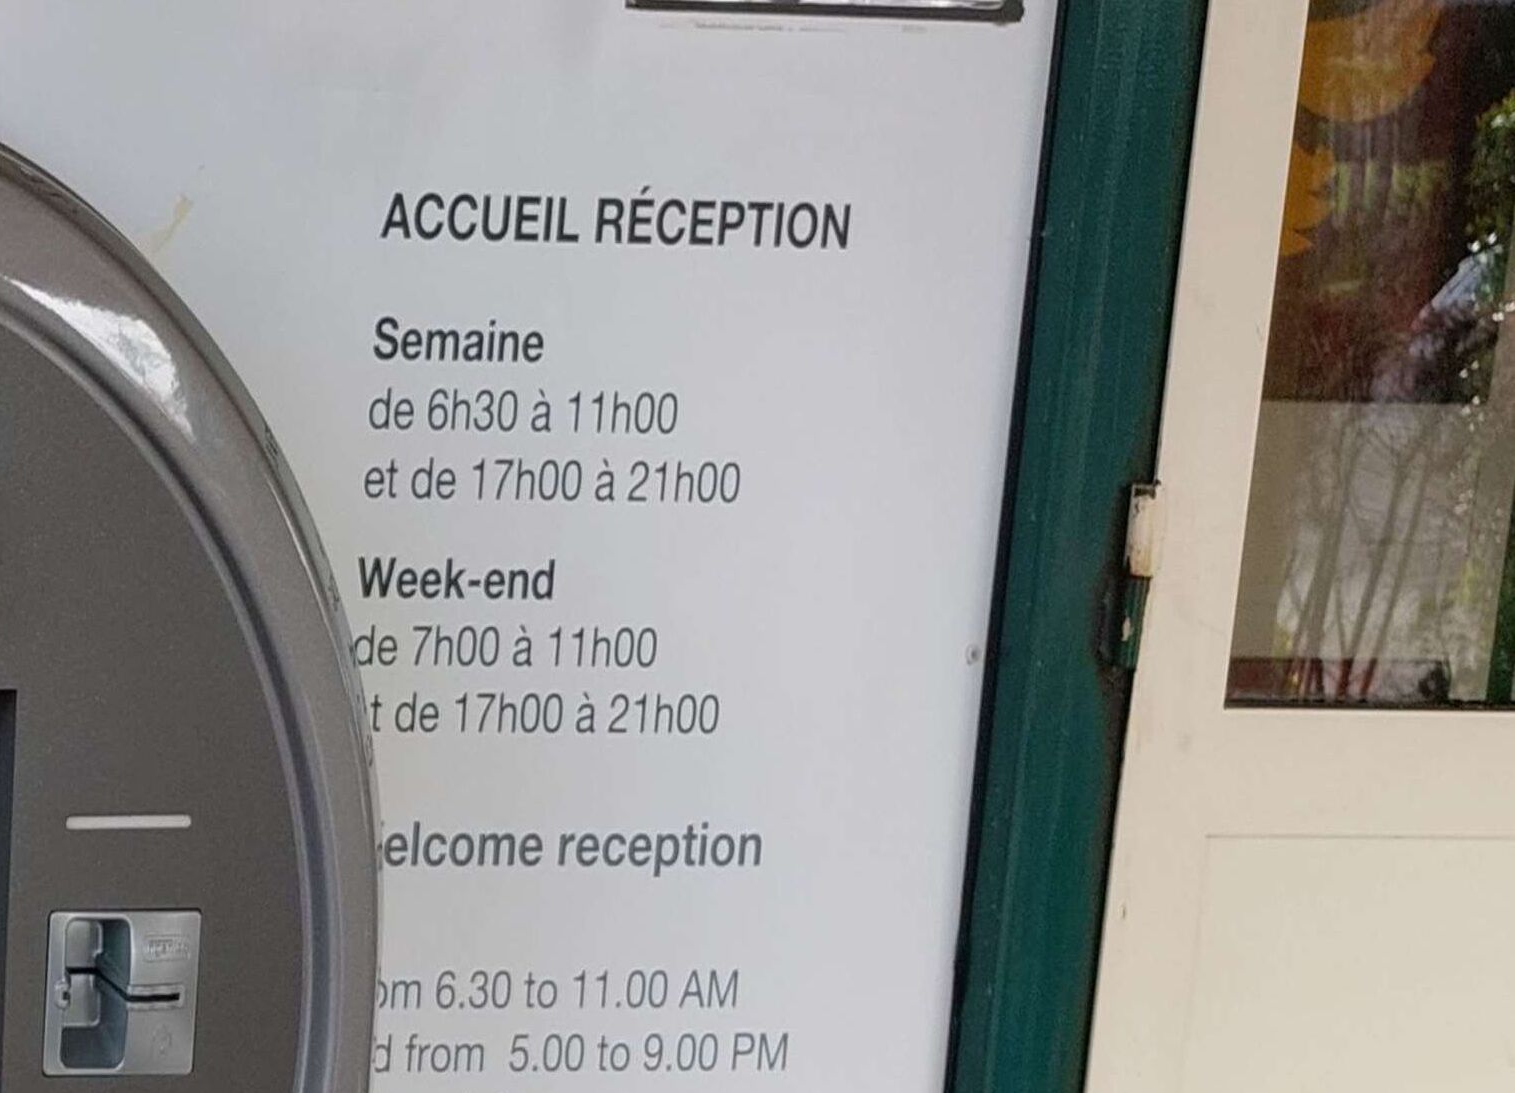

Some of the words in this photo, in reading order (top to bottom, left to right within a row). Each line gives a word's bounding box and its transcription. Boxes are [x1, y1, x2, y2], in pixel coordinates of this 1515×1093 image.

[380, 192, 580, 243] ACCUEIL
[595, 185, 851, 249] RÉCEPTION
[373, 316, 544, 363] Semaine
[368, 387, 415, 431] de
[427, 388, 519, 432] 6h30
[530, 388, 552, 433] à
[568, 391, 678, 435] 11h00
[364, 459, 399, 499] et
[410, 457, 457, 500] de
[472, 458, 583, 502] 17h00
[594, 458, 615, 502] à
[627, 460, 741, 504] 21h00
[358, 556, 556, 600] Week-end
[353, 624, 398, 669] de
[412, 625, 500, 667] 7h00
[512, 624, 533, 667] à
[549, 626, 658, 668] 11h00
[394, 691, 440, 733] de
[455, 692, 564, 734] 17h00
[575, 691, 596, 734] à
[607, 693, 720, 734] 21h00
[383, 820, 543, 867] elcome
[557, 821, 762, 878] reception
[435, 970, 512, 1010] 6.30
[524, 971, 558, 1009] to
[573, 969, 668, 1009] 11.00
[678, 969, 739, 1009] AM
[405, 1033, 485, 1073] from
[508, 1033, 585, 1073] 5.00
[597, 1035, 631, 1072] to
[643, 1032, 719, 1072] 9.00
[731, 1032, 789, 1071] PM
